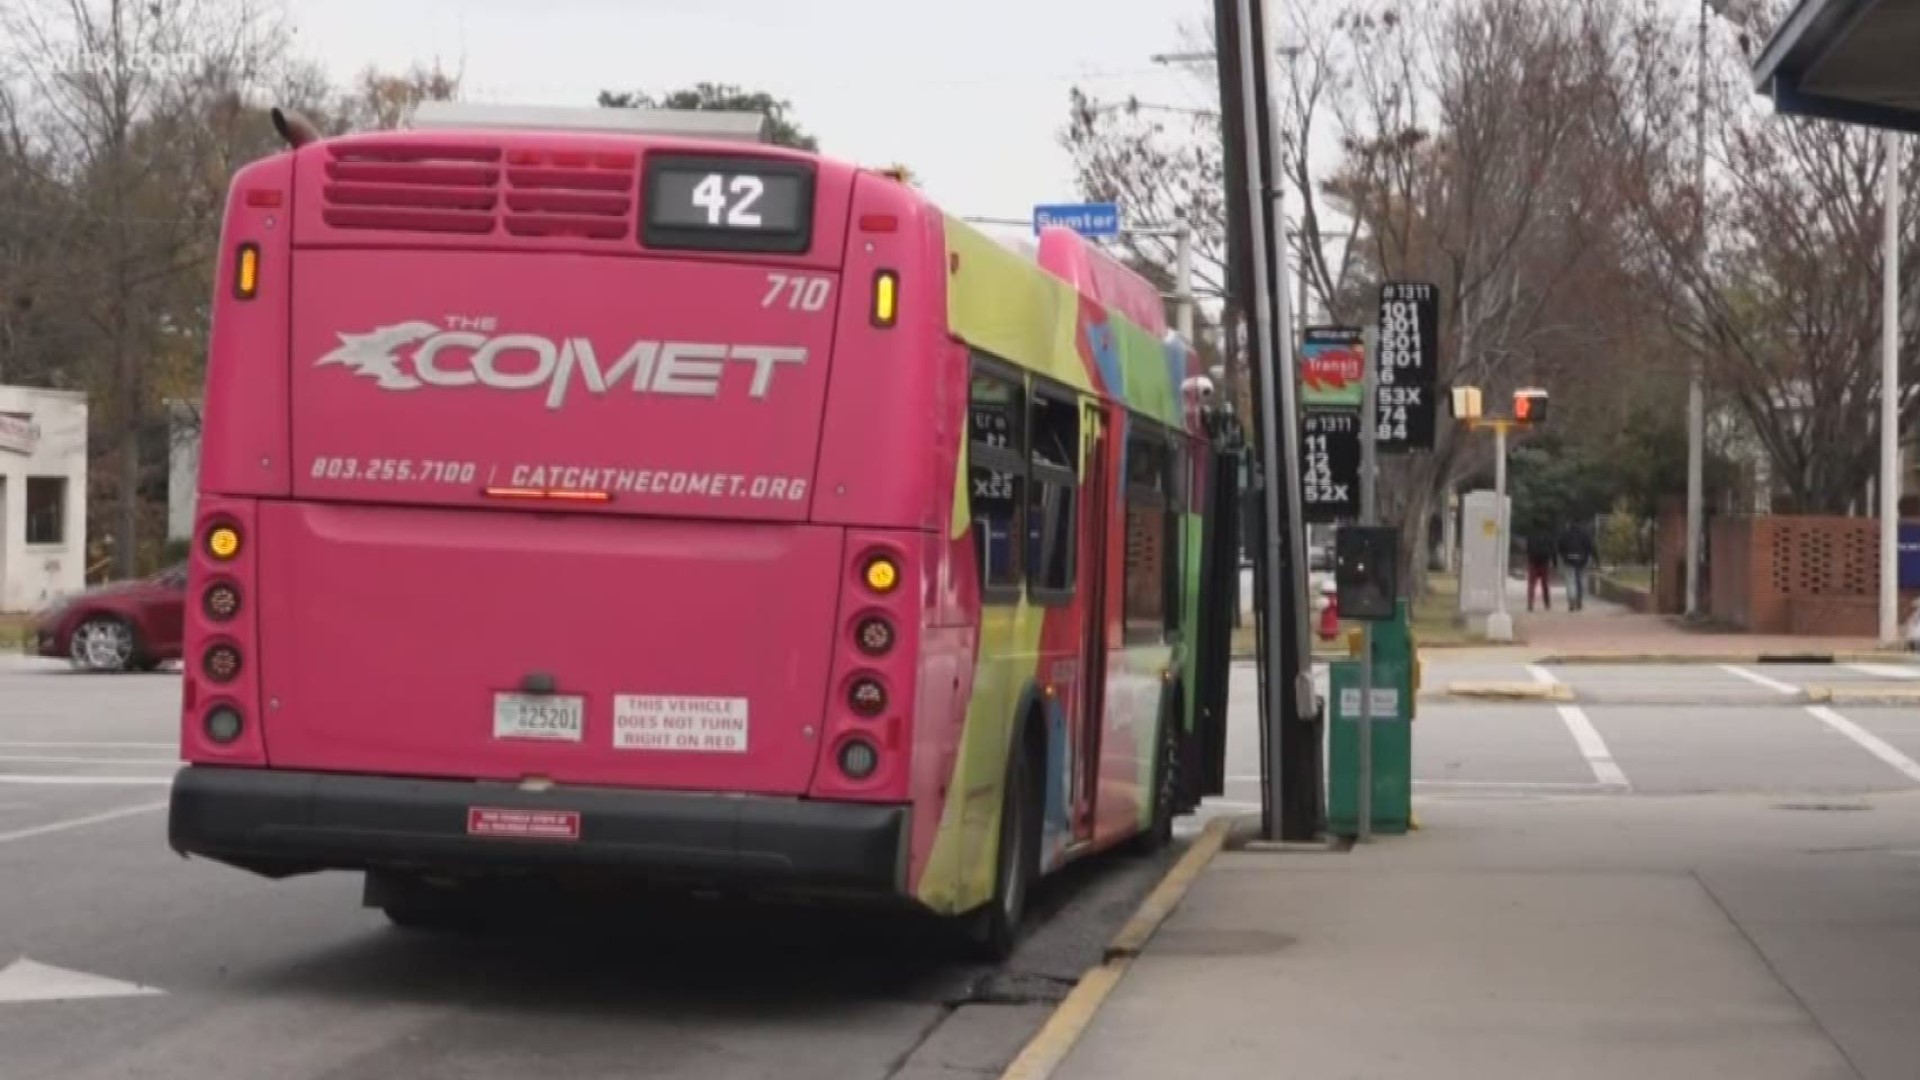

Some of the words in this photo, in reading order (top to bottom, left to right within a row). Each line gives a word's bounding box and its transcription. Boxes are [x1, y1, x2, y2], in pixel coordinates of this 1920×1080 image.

[692, 173, 764, 227] 42
[761, 273, 831, 312] 710
[1381, 302, 1418, 319] 101
[445, 315, 497, 331] THE
[411, 333, 807, 408] COMET
[1378, 388, 1421, 405] 53X
[1378, 405, 1408, 423] 74
[1305, 434, 1327, 451] 11
[310, 457, 476, 484] 803.255.7100
[511, 465, 807, 501] CATCHTHECOMET.ORG
[1304, 484, 1349, 502] 52X
[629, 697, 664, 711] THIS
[668, 699, 732, 713] VEHICLE
[617, 715, 658, 729] DOES
[663, 716, 693, 730] NOT
[701, 717, 744, 731] TURN
[624, 733, 670, 745] RIGHT
[676, 735, 699, 746] ON
[704, 735, 736, 748] RED
